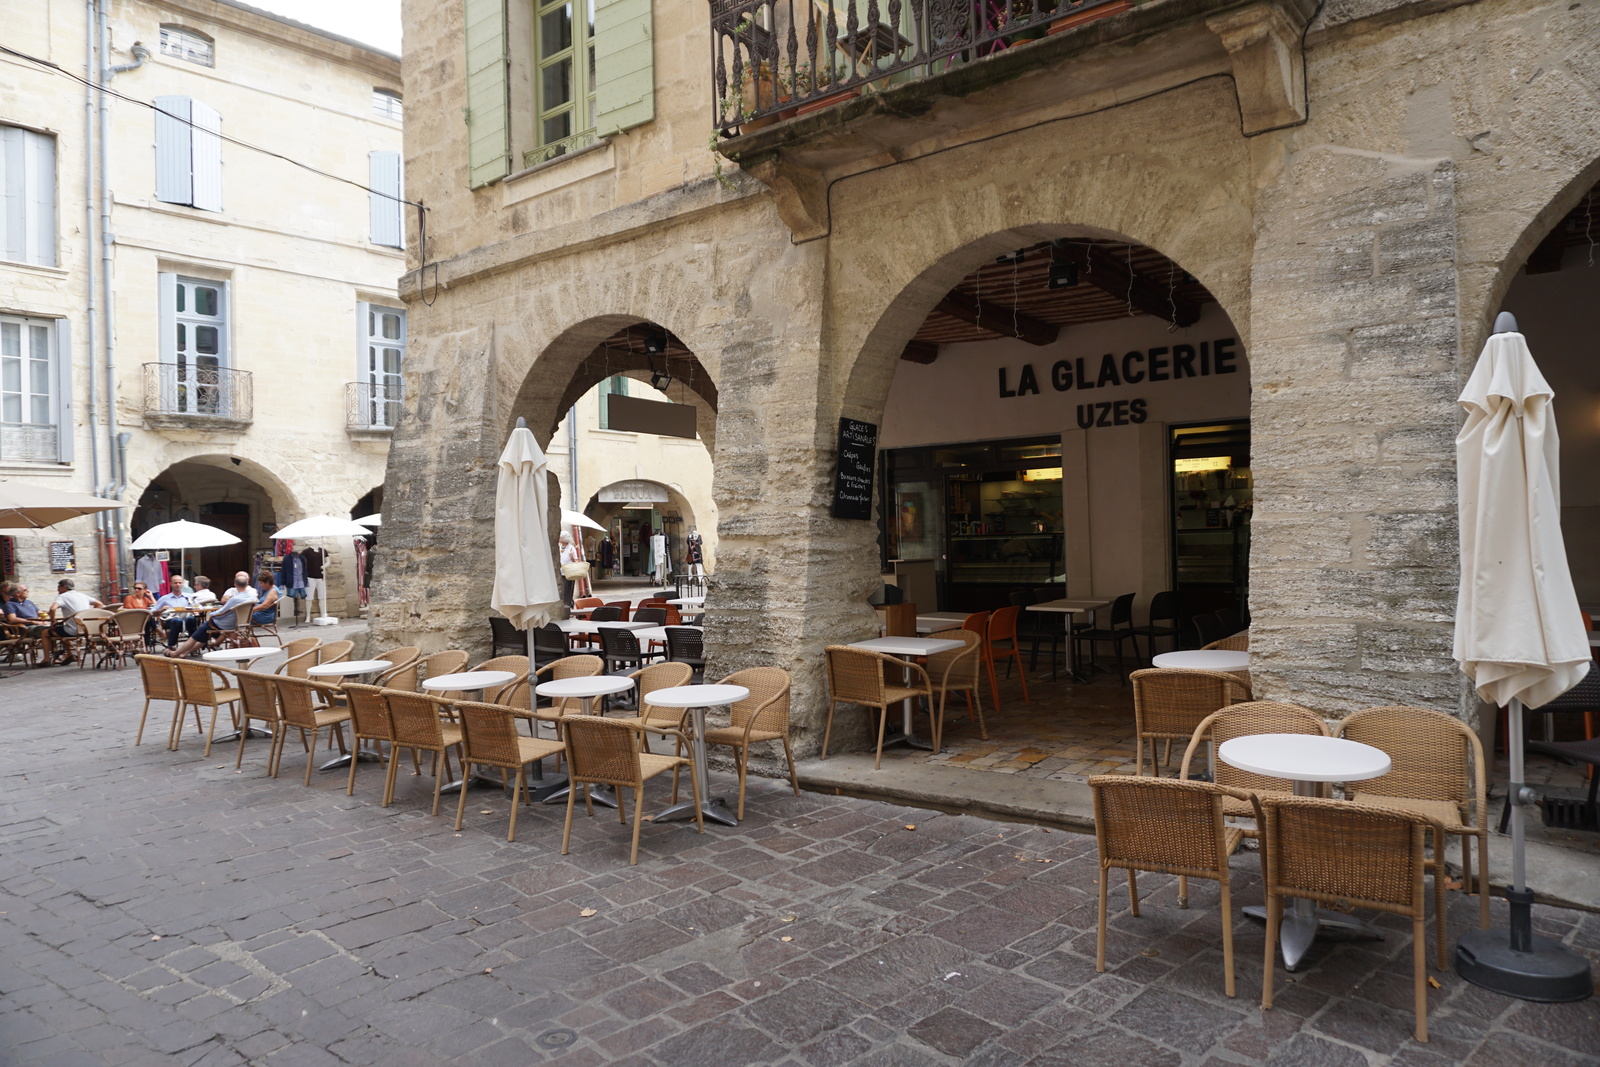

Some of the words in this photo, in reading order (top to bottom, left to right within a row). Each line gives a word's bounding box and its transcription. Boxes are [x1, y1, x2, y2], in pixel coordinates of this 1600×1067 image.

[999, 364, 1040, 398] LA
[1051, 337, 1237, 392] GLACERIE
[849, 420, 868, 433] GLACES
[1076, 398, 1148, 429] UZES
